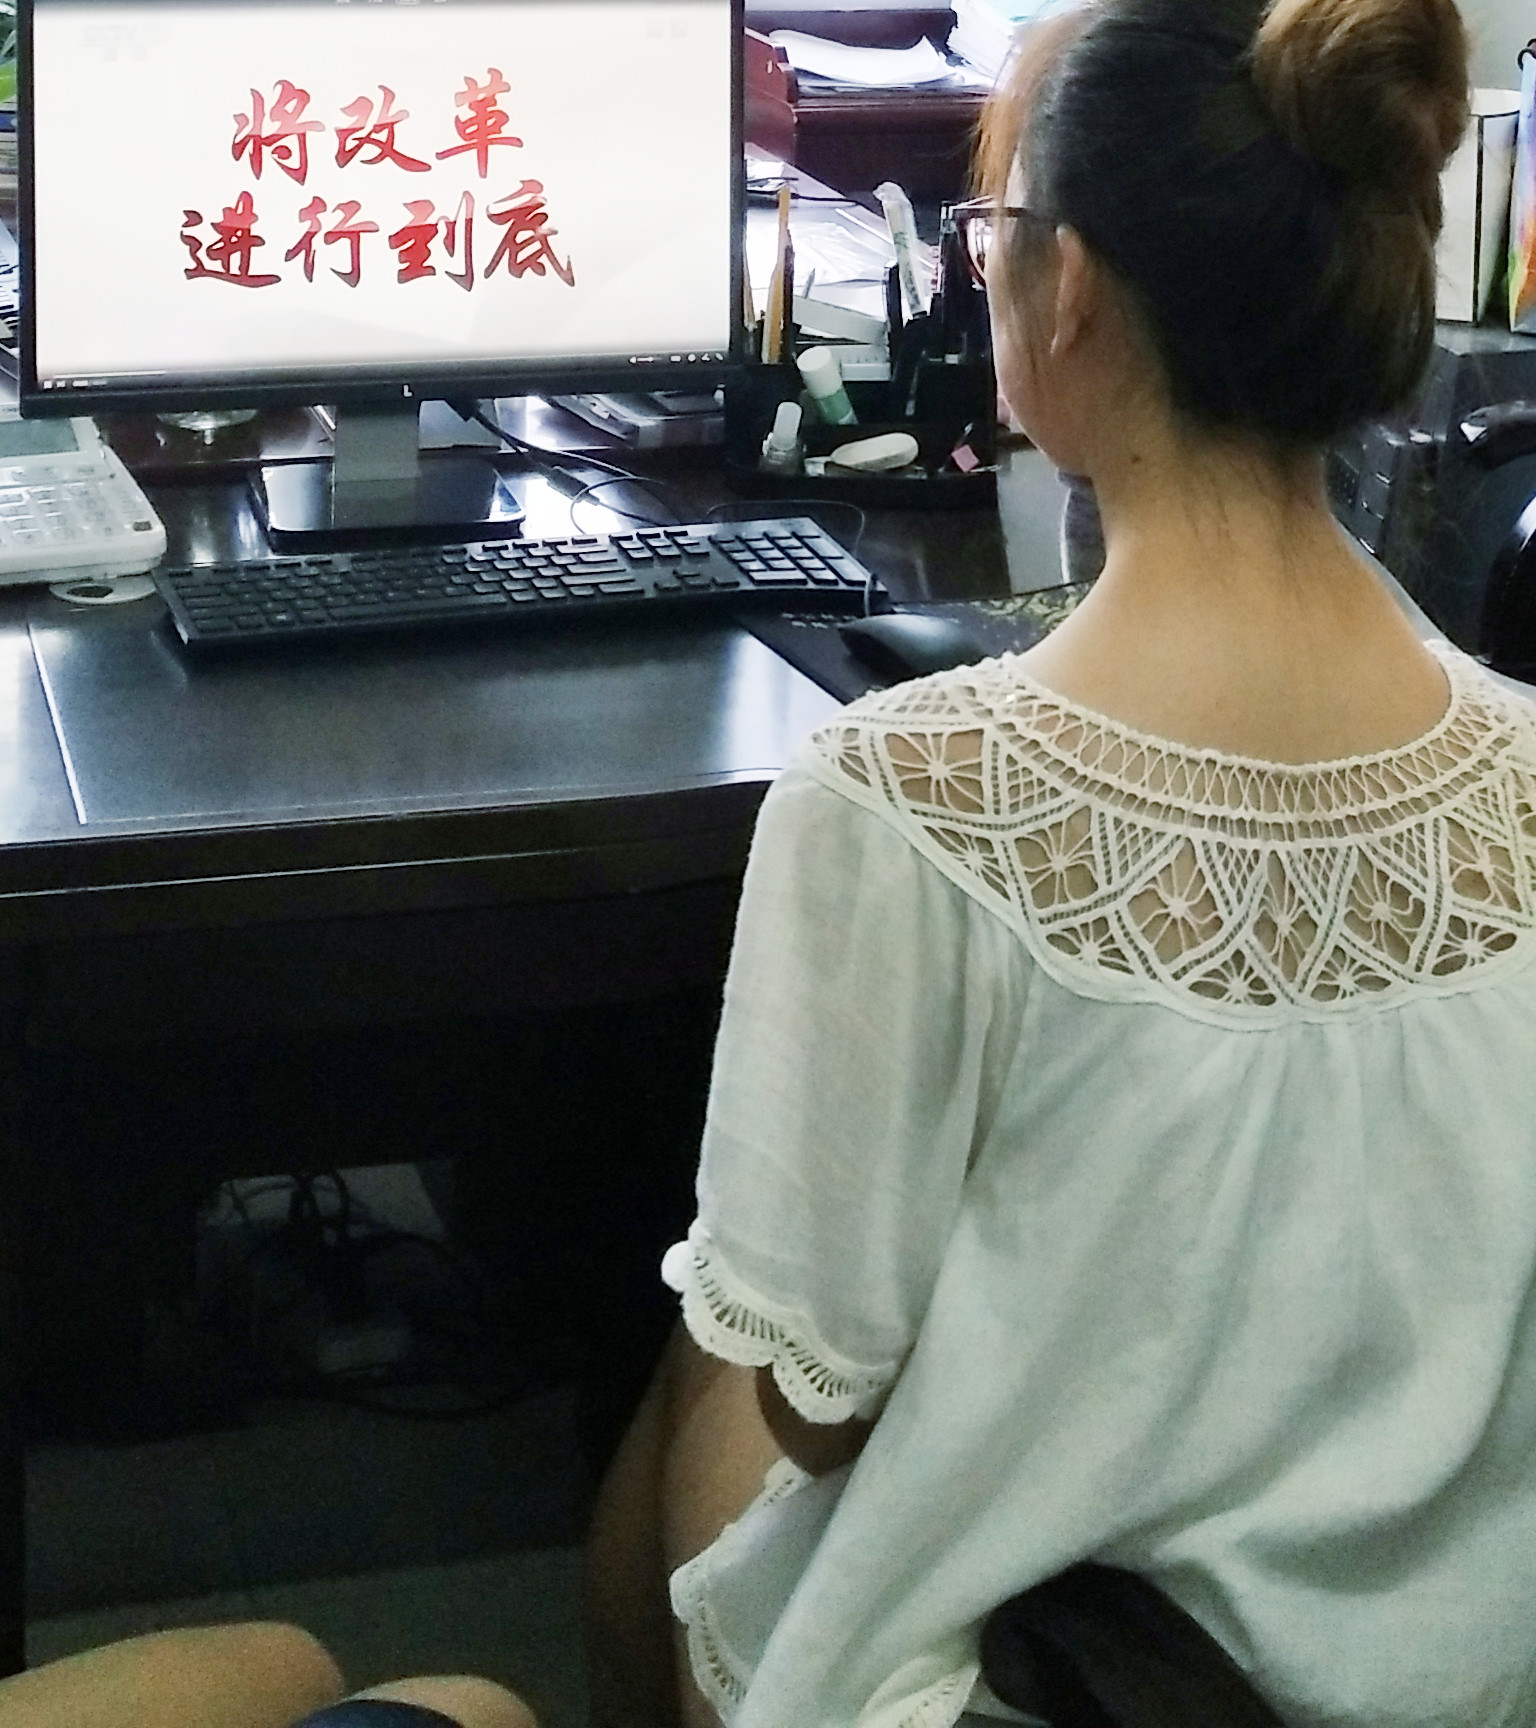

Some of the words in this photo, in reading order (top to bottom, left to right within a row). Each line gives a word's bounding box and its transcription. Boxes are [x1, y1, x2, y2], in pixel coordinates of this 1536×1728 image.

[231, 68, 524, 184] 将改革
[179, 180, 575, 291] 进行到底
